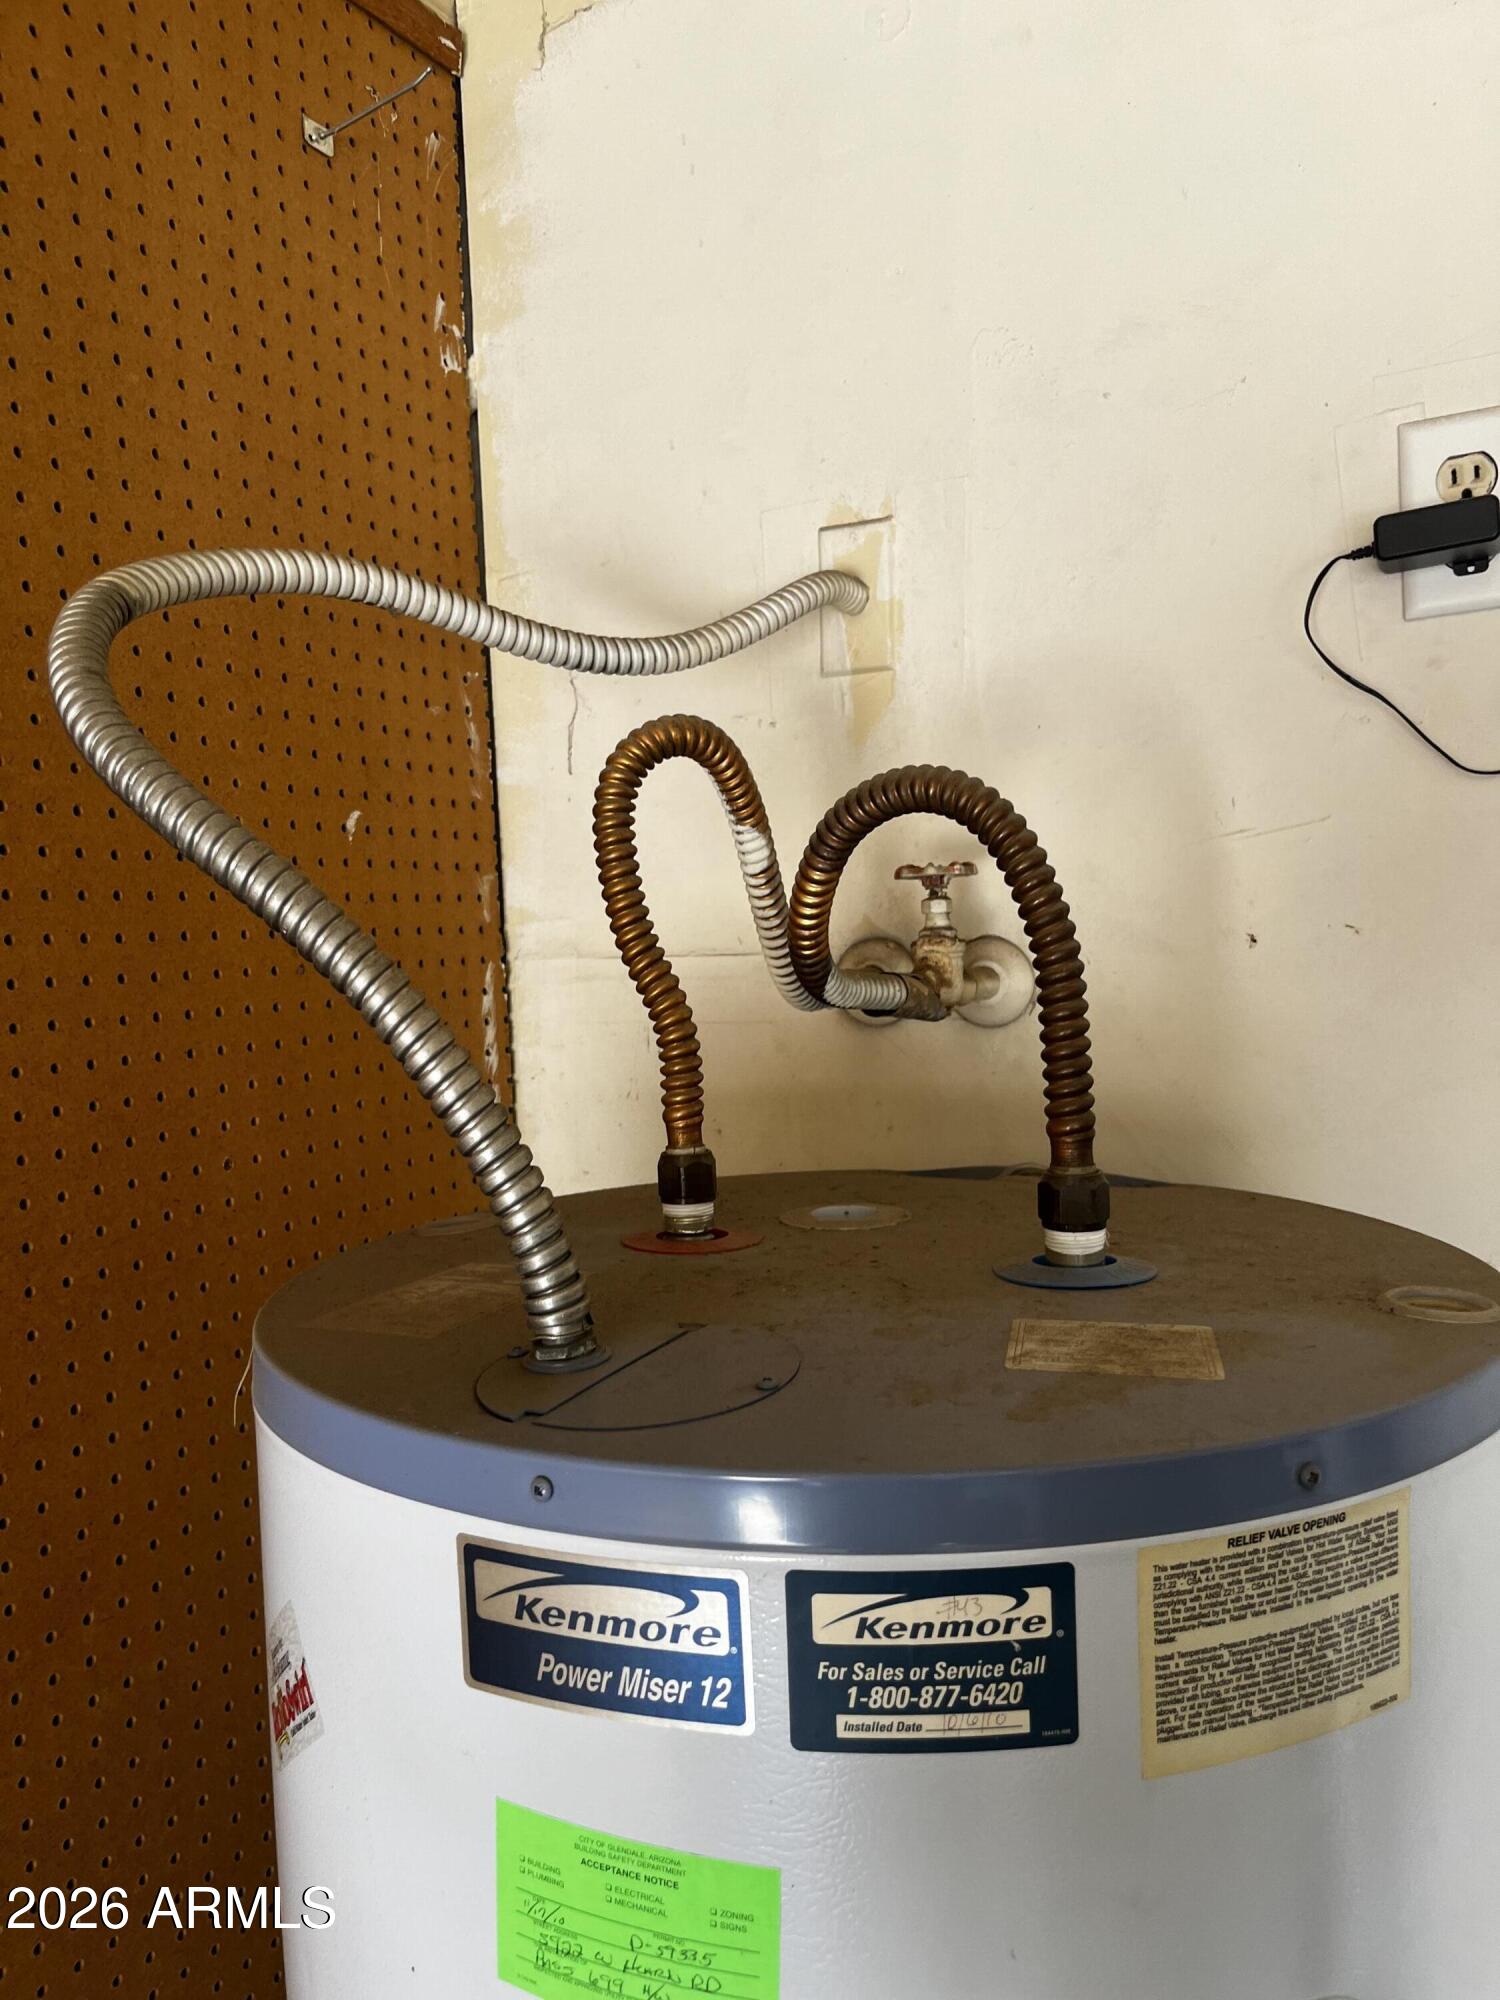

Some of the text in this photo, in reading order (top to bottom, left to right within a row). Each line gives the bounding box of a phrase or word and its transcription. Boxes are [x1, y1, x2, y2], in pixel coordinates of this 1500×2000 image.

[1227, 1512, 1346, 1548] RELIEF VALVE OPENING
[1153, 1580, 1177, 1590] Z21.22
[1204, 1574, 1215, 1582] 4.4
[514, 1594, 722, 1647] Kenmore
[854, 1614, 1047, 1639] Kenmore
[536, 1652, 732, 1709] Power Miser 12
[817, 1655, 1047, 1681] For Sales or Service Call
[847, 1681, 1024, 1709] 1-800-877-6420
[843, 1720, 923, 1733] Installed Date
[574, 1842, 686, 1877] BUILDING SAFETY DEPARTMENT
[578, 1834, 595, 1845] CITY
[595, 1839, 605, 1849] OF
[648, 1854, 681, 1867] ARIZONA
[527, 1856, 561, 1876] BUILDING
[527, 1867, 565, 1889] PLUMBING
[580, 1857, 679, 1890] ACCEPTANCE NOTICE
[614, 1885, 665, 1905] ELECTRICAL
[614, 1897, 668, 1918] MECHANICAL
[720, 1909, 755, 1923] ZONING
[720, 1922, 748, 1934] SIGNS
